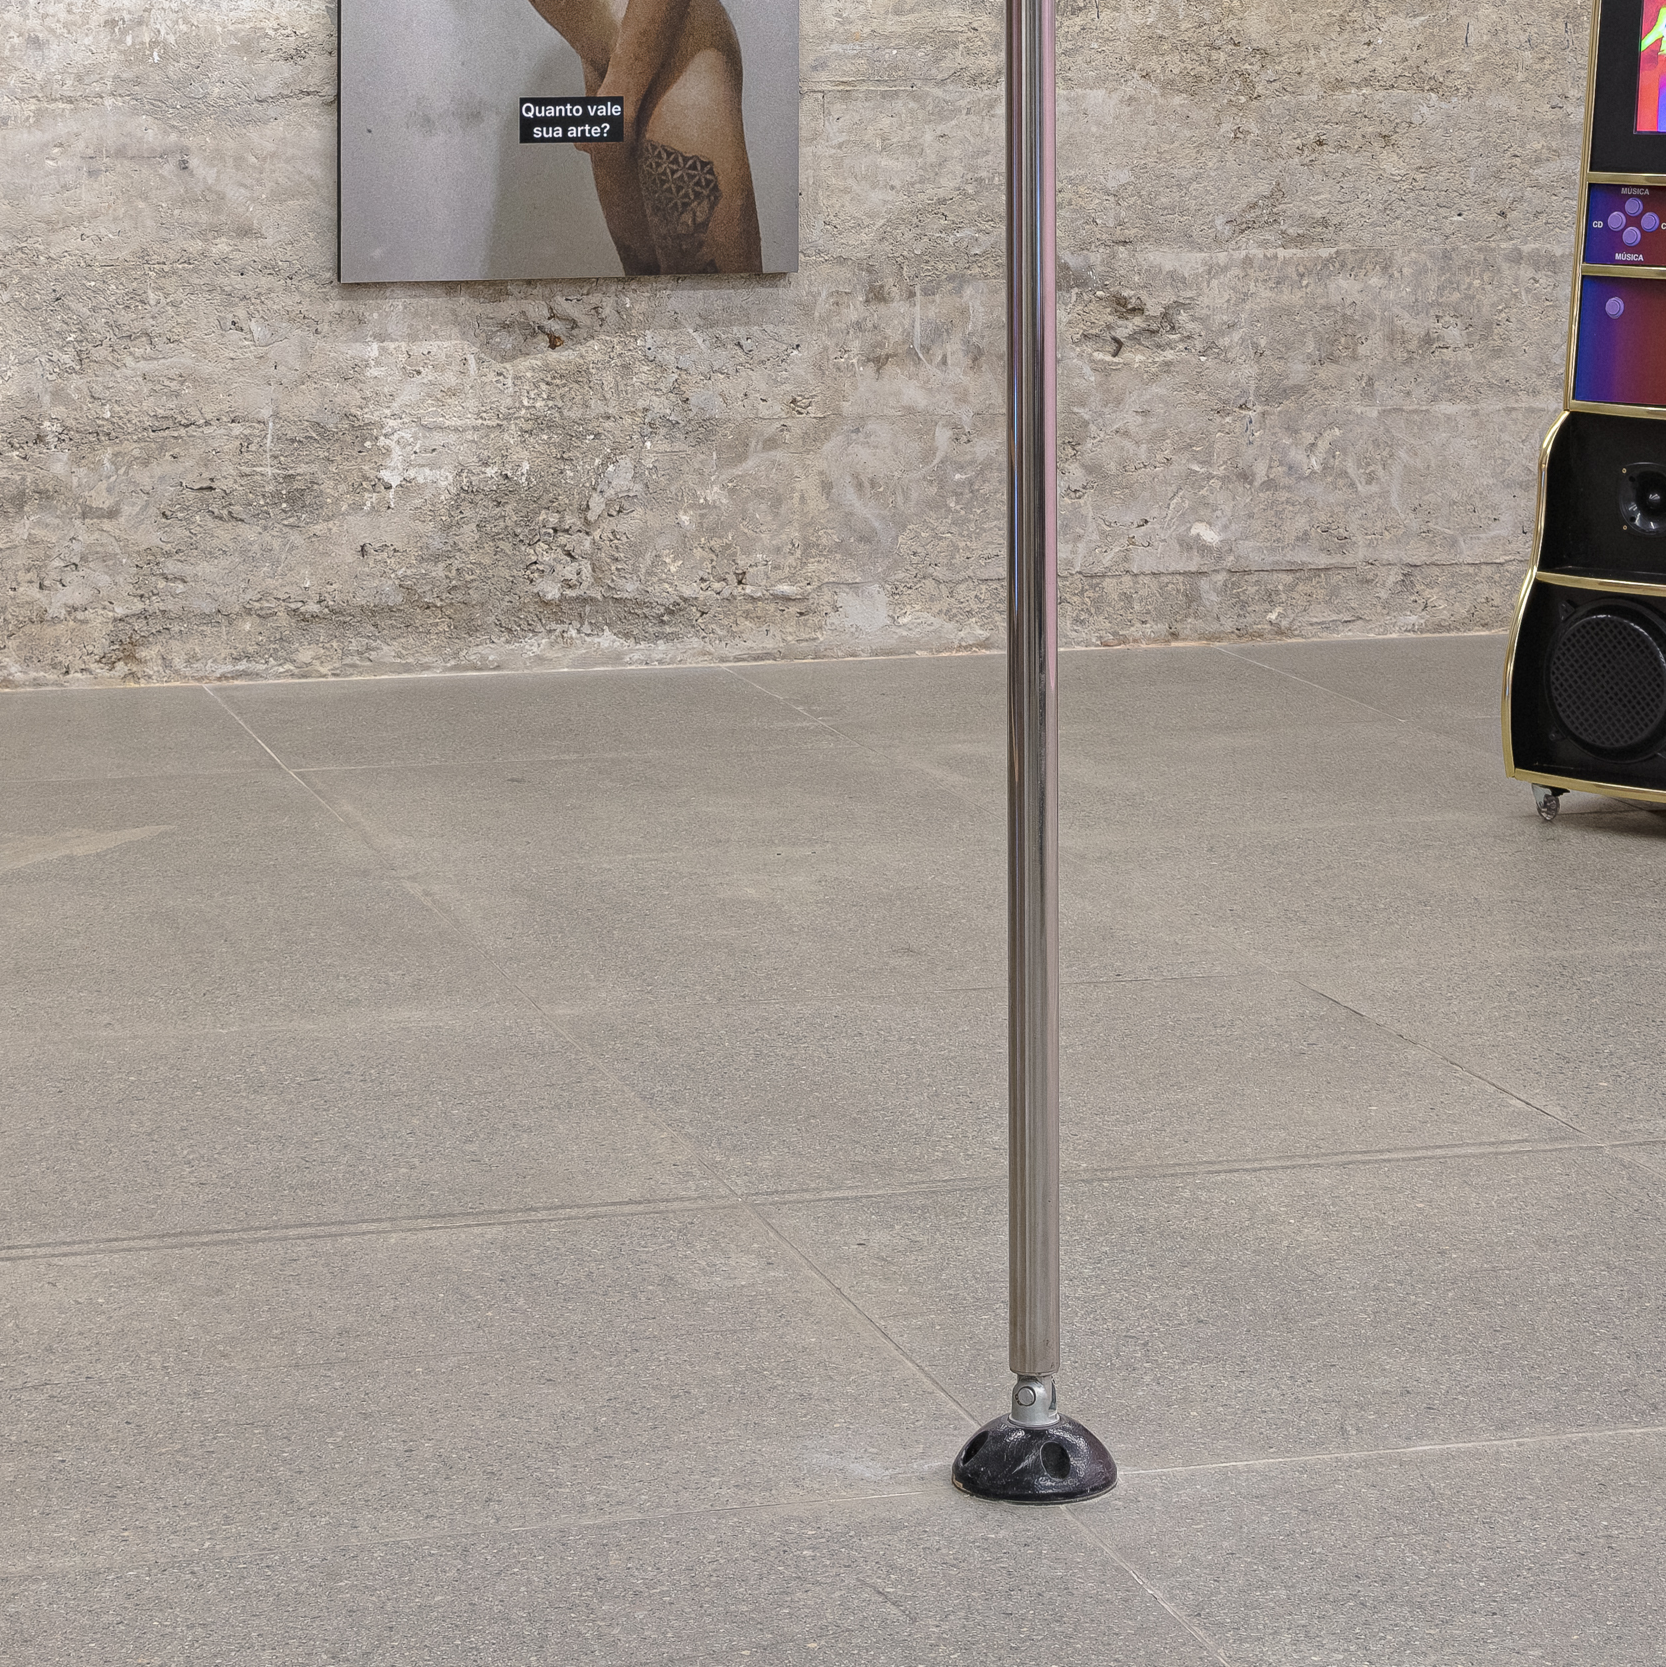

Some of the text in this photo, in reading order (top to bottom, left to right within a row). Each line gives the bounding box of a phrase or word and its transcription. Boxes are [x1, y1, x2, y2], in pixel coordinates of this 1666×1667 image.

[521, 101, 622, 119] Quanto vale
[533, 123, 611, 139] sua arte?
[1621, 186, 1650, 196] MÚSICA
[1592, 220, 1604, 229] CD
[1615, 251, 1644, 262] MÚSICA
